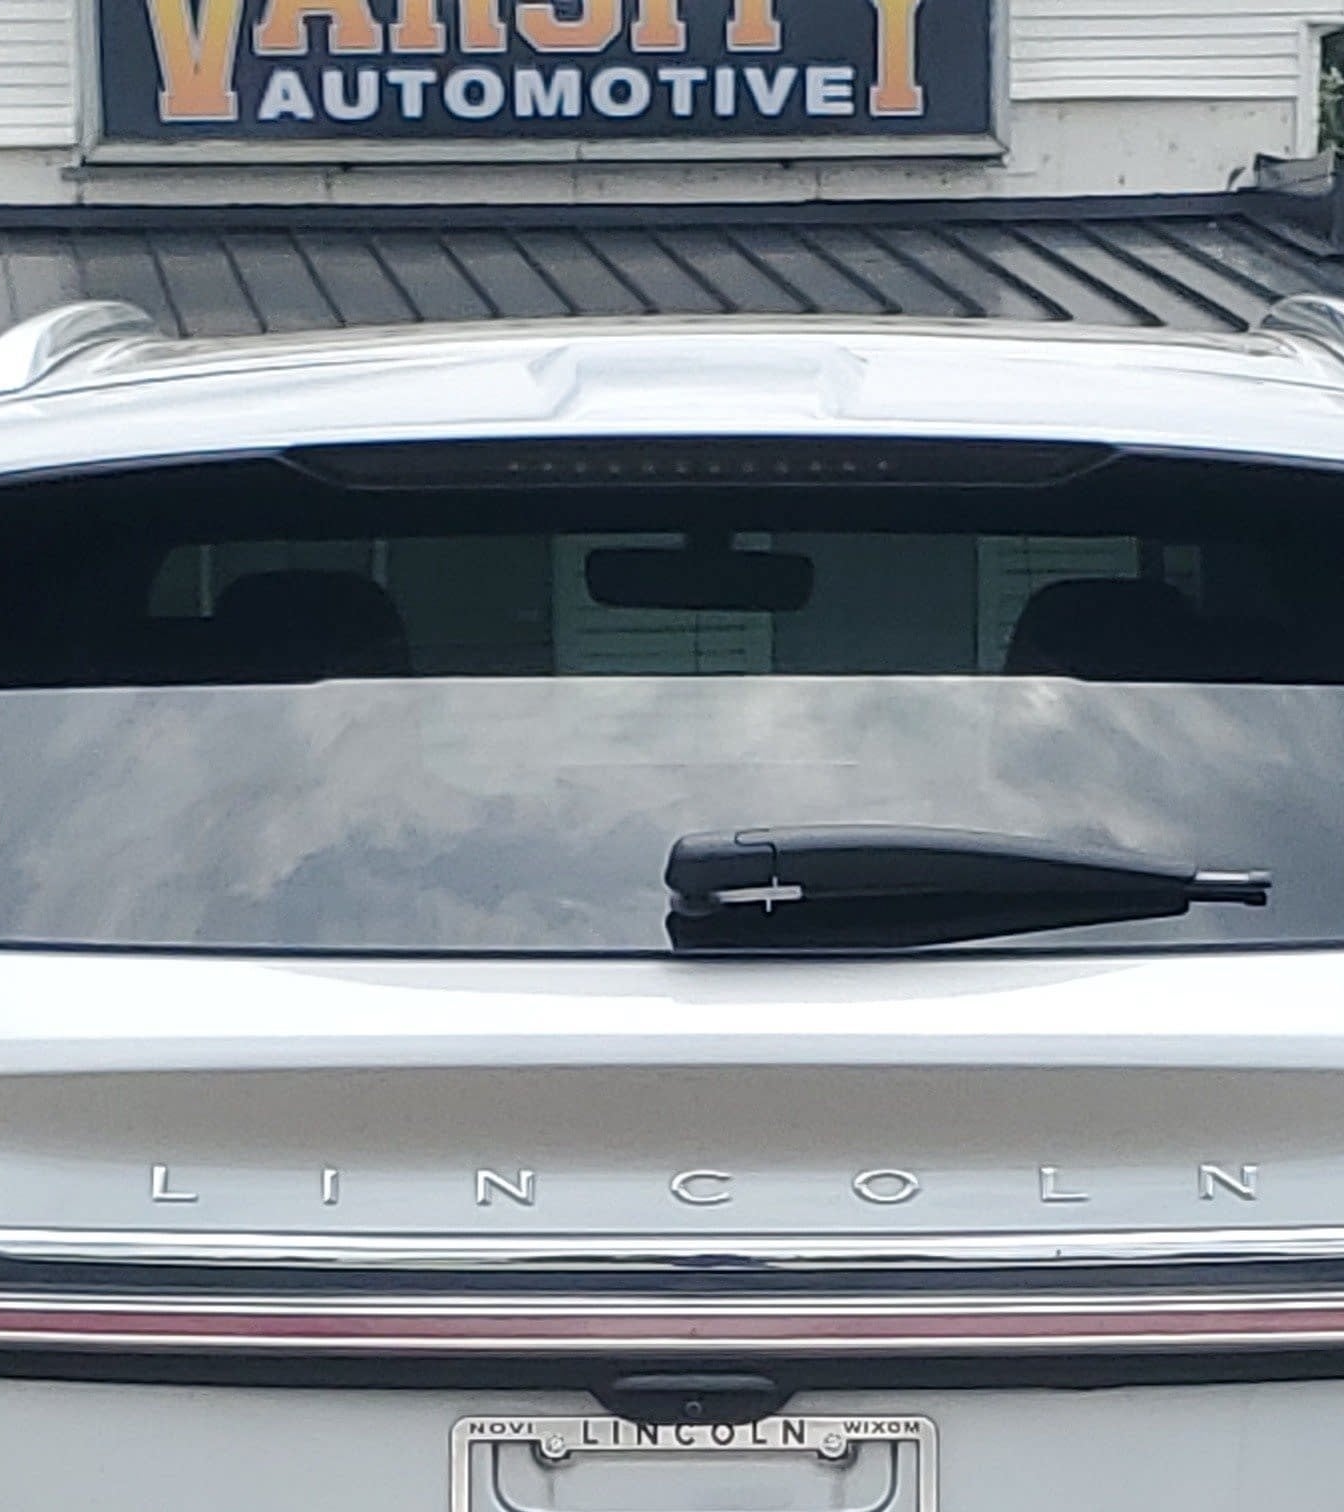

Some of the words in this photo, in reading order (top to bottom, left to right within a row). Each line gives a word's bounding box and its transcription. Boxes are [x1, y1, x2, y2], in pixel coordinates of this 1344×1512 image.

[258, 66, 856, 119] AUTOMOTIVE
[152, 1164, 1260, 1205] LINCOLN
[469, 1422, 533, 1434] NOVI
[582, 1419, 805, 1446] LINCOLN
[843, 1421, 921, 1434] WIXOM
